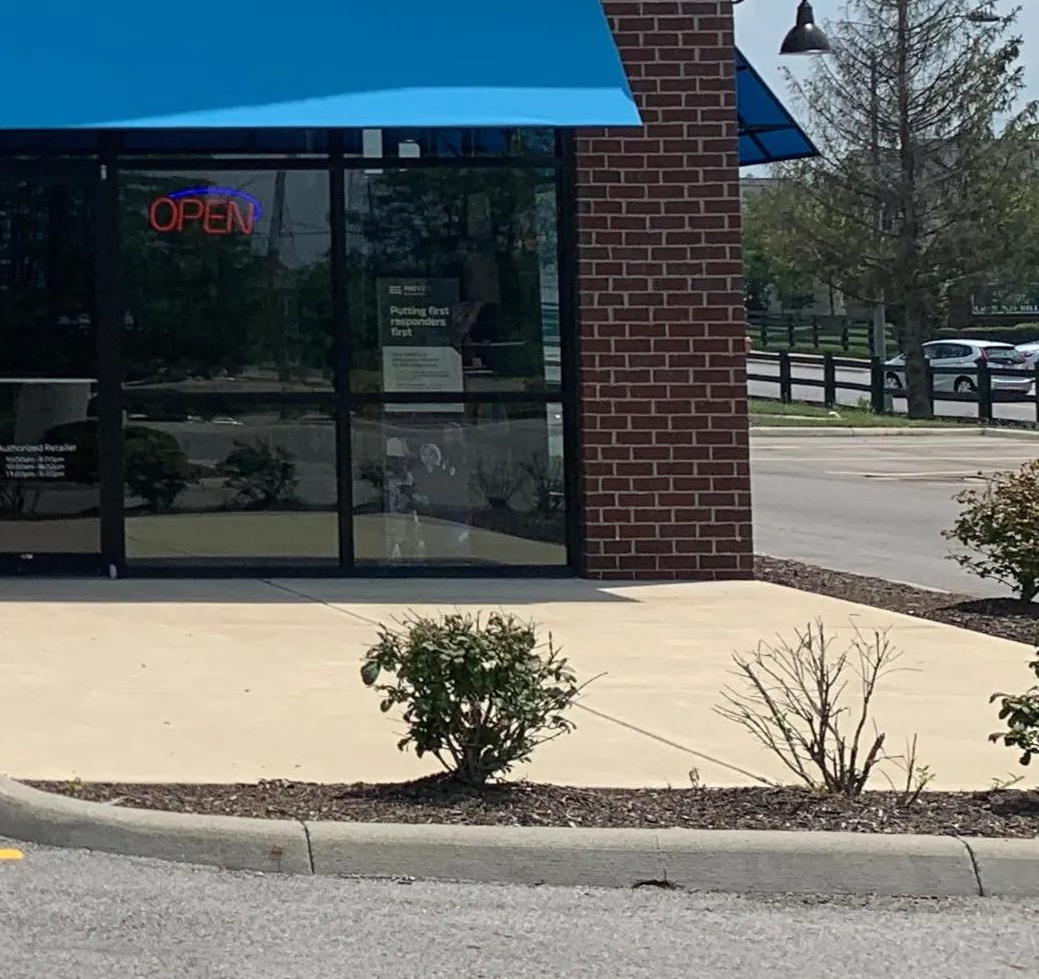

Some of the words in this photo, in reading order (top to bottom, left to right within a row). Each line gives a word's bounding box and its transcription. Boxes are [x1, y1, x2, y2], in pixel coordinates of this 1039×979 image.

[149, 196, 255, 235] OPEN
[389, 306, 427, 317] Putting
[428, 306, 450, 316] first
[390, 317, 446, 328] responders
[391, 327, 413, 337] first
